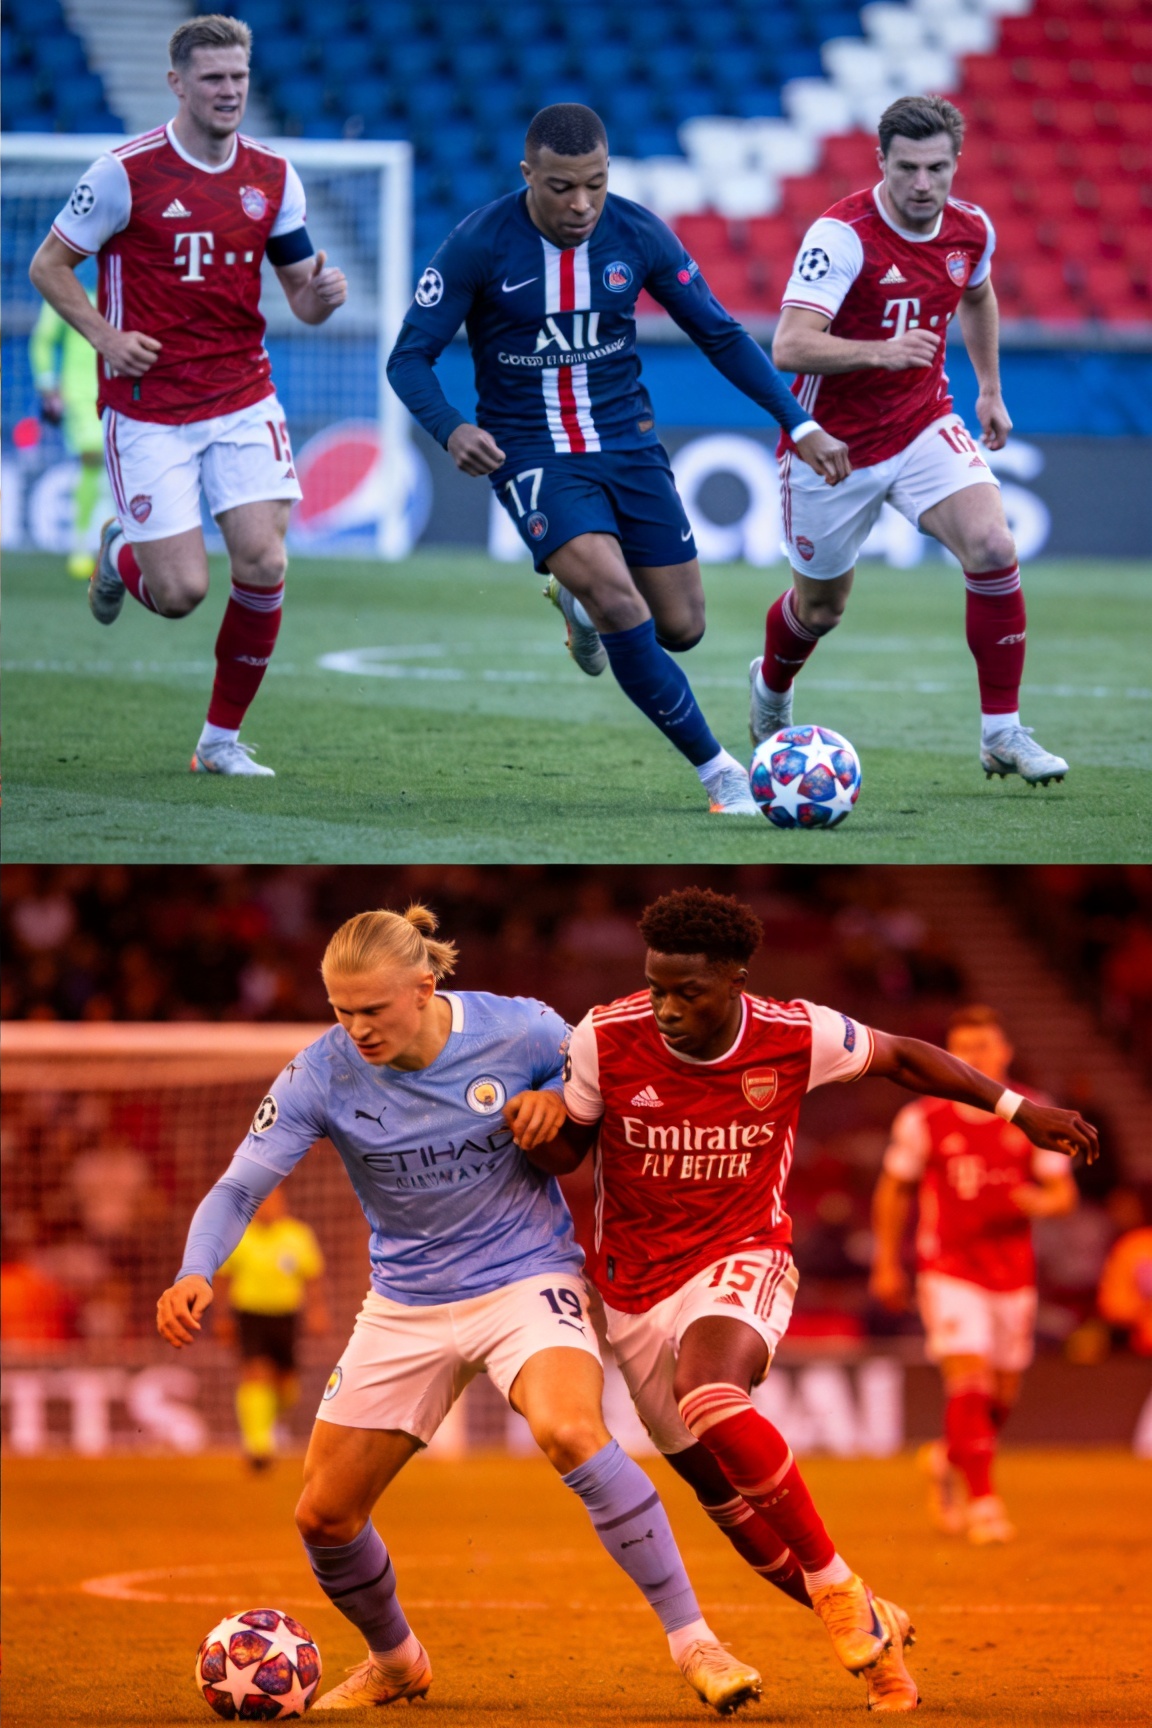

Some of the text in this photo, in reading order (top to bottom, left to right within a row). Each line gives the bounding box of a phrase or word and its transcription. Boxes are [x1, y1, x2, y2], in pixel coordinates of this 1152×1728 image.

[504, 467, 543, 518] 17
[622, 1116, 776, 1151] Emirates
[641, 1152, 752, 1181] FLY BETTER
[708, 1260, 762, 1292] 15
[539, 1288, 583, 1322] 19
